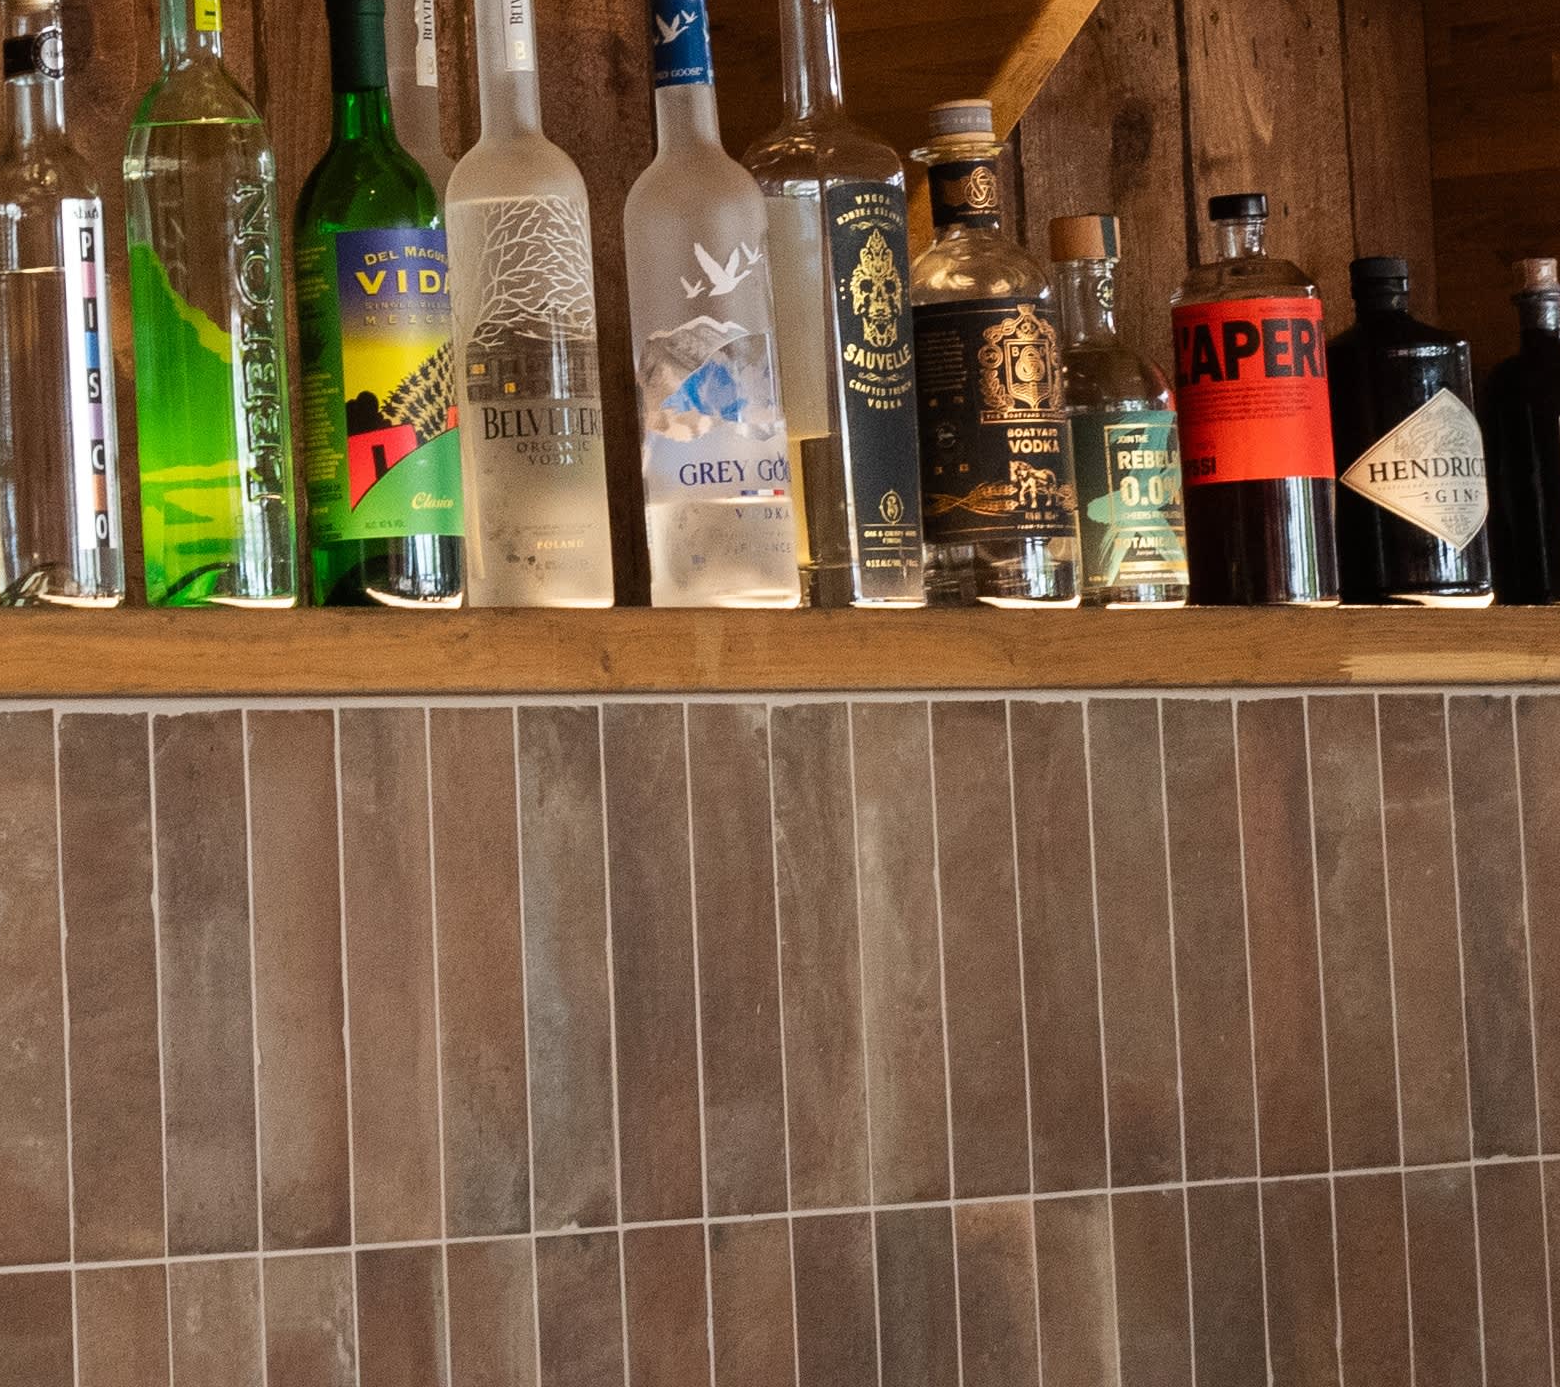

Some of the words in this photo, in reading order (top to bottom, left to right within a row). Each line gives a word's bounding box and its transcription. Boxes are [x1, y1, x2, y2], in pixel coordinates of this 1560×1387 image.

[843, 343, 912, 371] SAUVELLE
[867, 398, 902, 409] VODKA
[1008, 439, 1060, 454] VODKA
[680, 460, 747, 487] GREY
[1436, 490, 1473, 502] GIN
